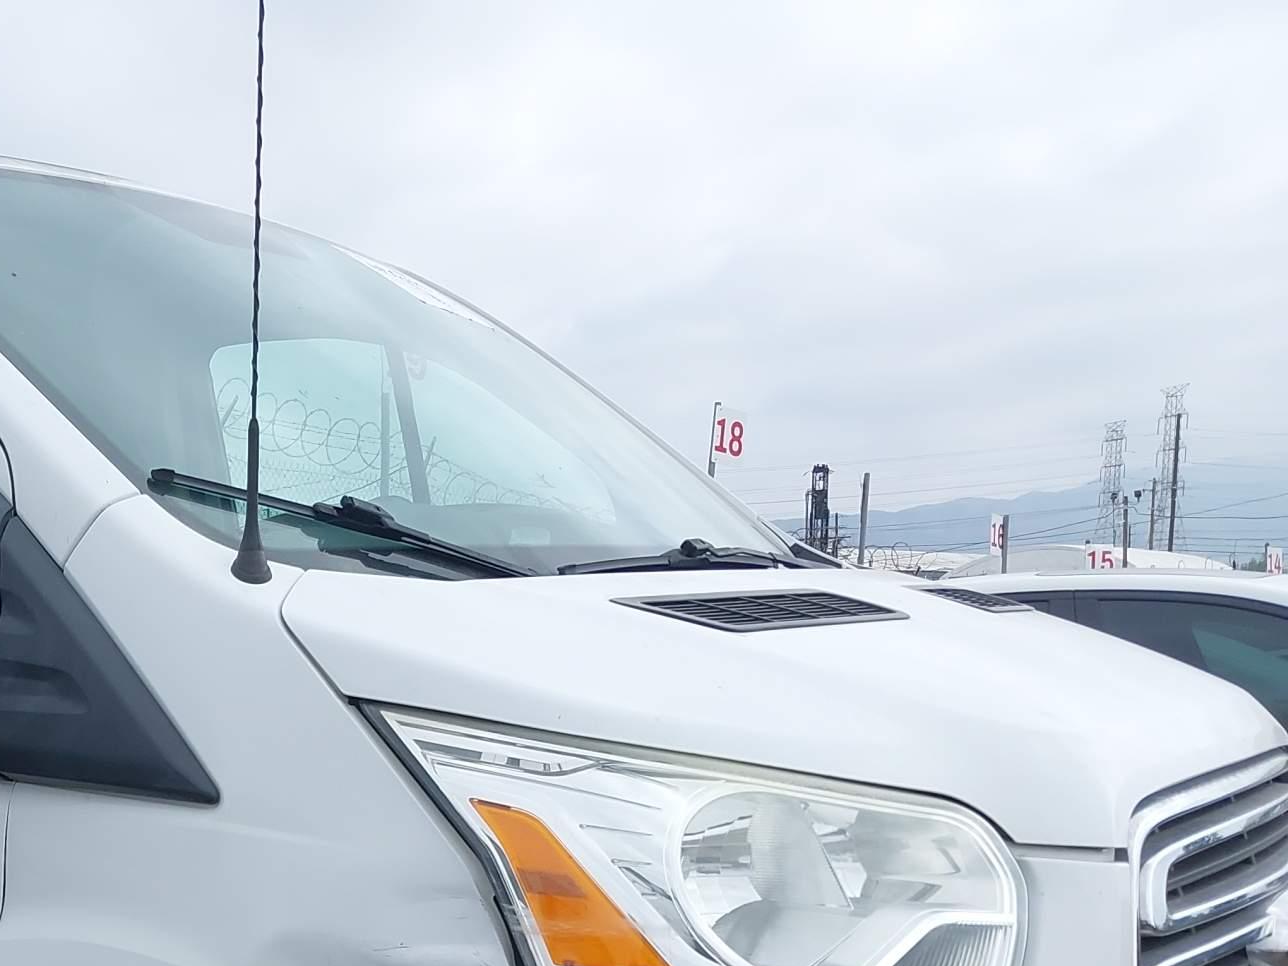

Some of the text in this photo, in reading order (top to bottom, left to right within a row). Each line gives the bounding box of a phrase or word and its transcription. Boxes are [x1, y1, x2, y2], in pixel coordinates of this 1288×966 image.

[714, 418, 744, 457] 18
[1087, 550, 1114, 569] 15
[1268, 553, 1281, 575] 14
